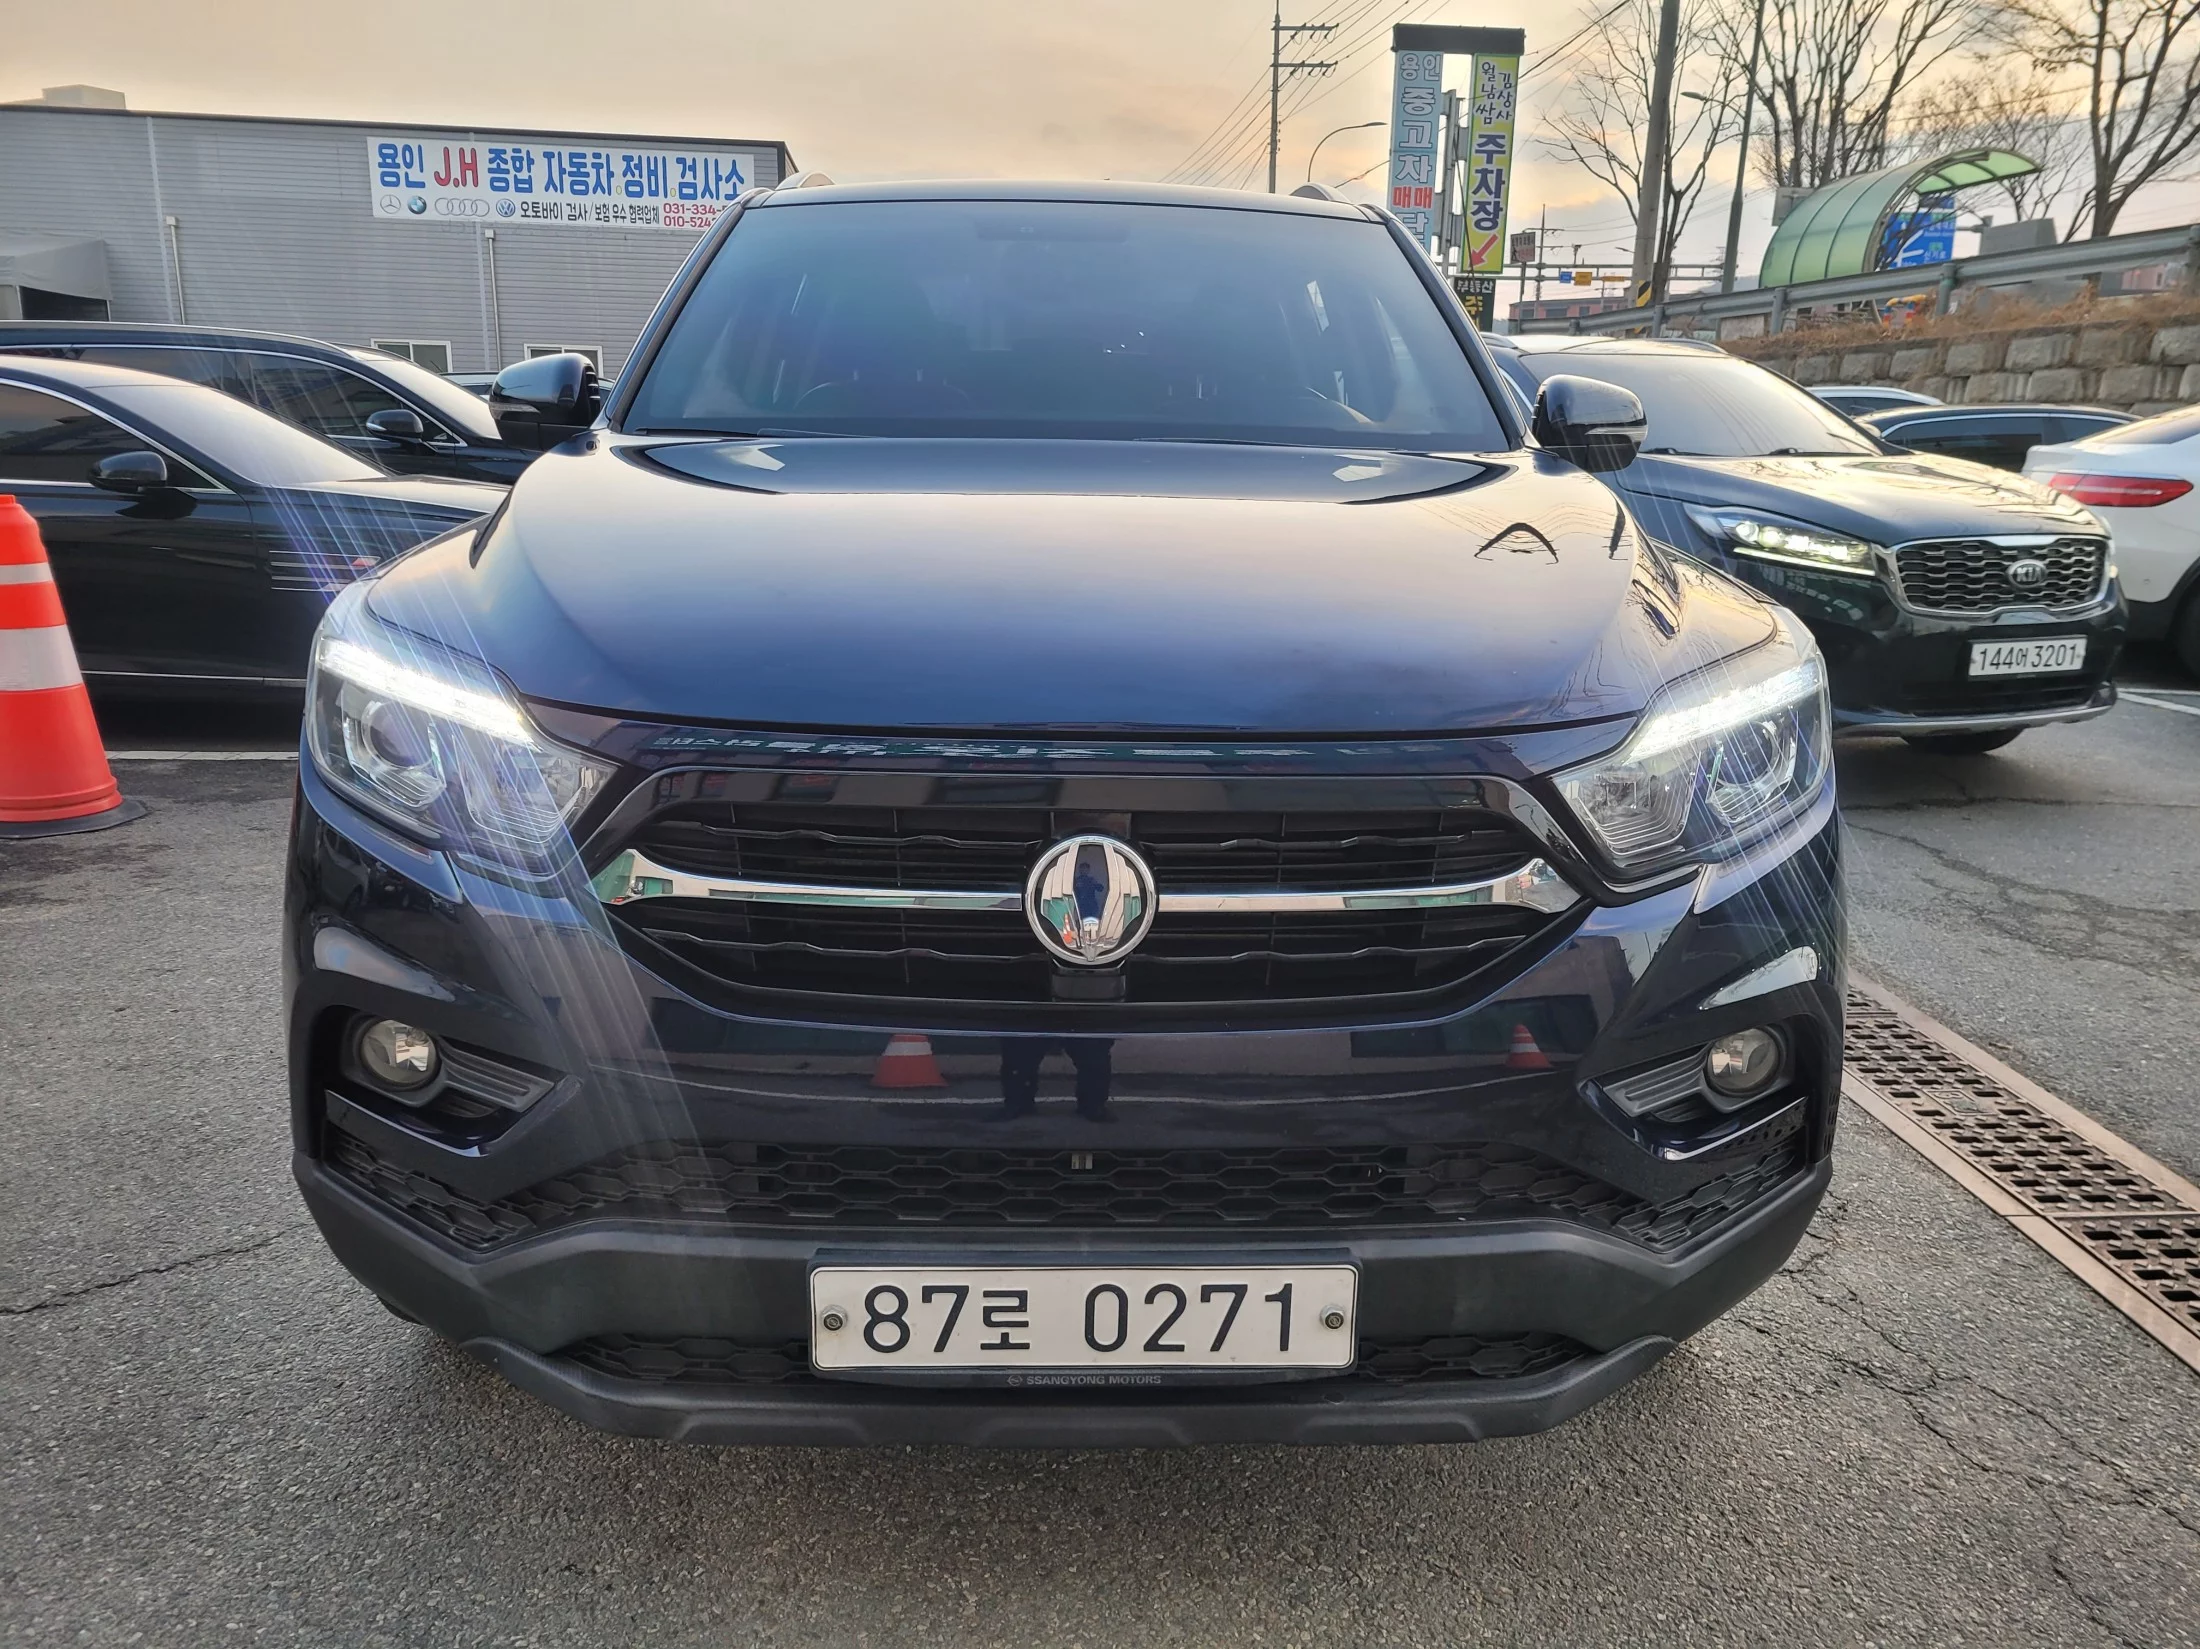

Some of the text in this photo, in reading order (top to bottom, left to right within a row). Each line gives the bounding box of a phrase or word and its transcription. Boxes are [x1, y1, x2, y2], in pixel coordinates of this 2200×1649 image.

[1401, 53, 1441, 81] 용인
[377, 143, 426, 189] 용인
[487, 148, 535, 193] 종합
[1470, 133, 1506, 231] 주차장
[1392, 186, 1433, 209] 매매
[520, 201, 563, 220] 오토바이
[612, 205, 627, 223] 우수
[629, 205, 660, 224] 협력업체
[663, 215, 717, 228] 010-524
[2016, 566, 2043, 582] KIA
[863, 1283, 1293, 1354] 87로 0271
[1026, 1375, 1162, 1385] SSANGYONG MOTORS
